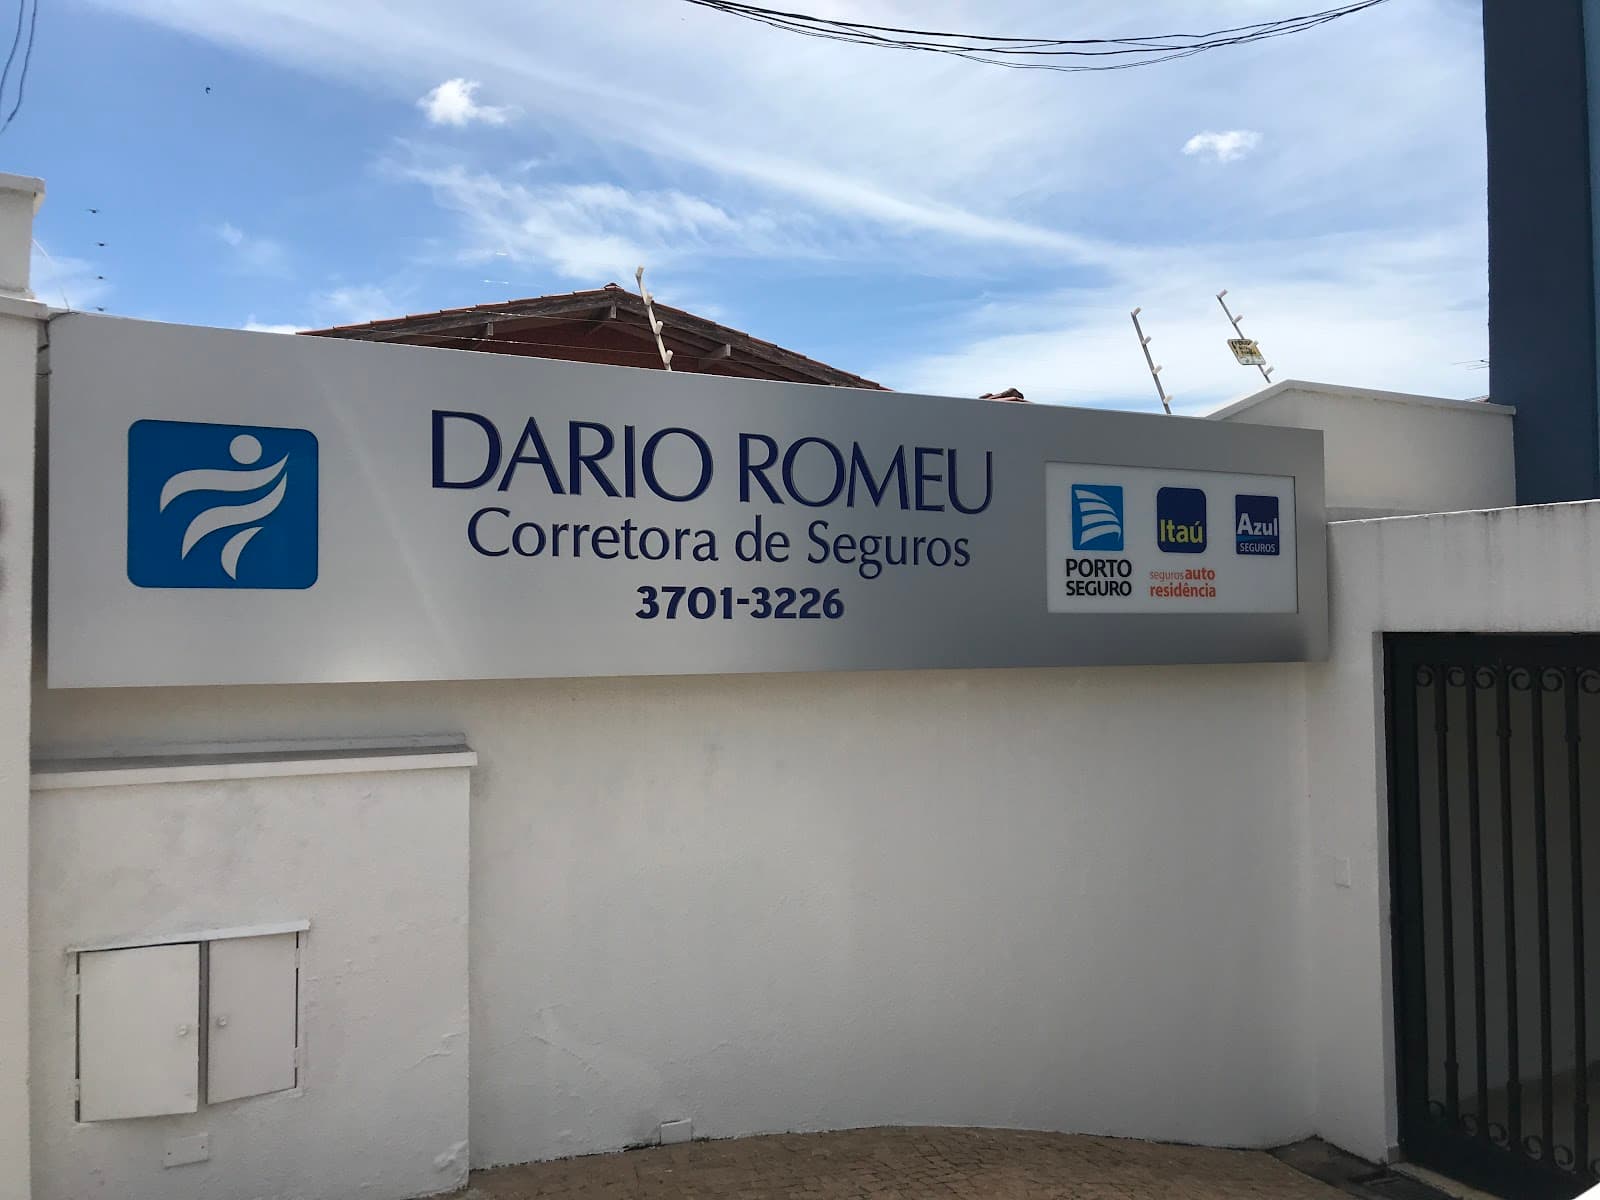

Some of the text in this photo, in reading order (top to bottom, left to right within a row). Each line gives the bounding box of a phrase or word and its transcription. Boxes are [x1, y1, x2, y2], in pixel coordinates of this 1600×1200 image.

[431, 409, 994, 515] DARIO ROMEU
[1159, 518, 1203, 544] Itaú
[1236, 512, 1278, 537] Azul
[467, 506, 971, 580] Corretora de Seguros
[1239, 542, 1276, 554] SEGUROS
[1065, 558, 1132, 578] PORTO
[1149, 567, 1216, 582] seguros auto
[1065, 580, 1132, 597] SEGURO
[1149, 583, 1216, 598] residência
[635, 585, 845, 620] 3701-3226
